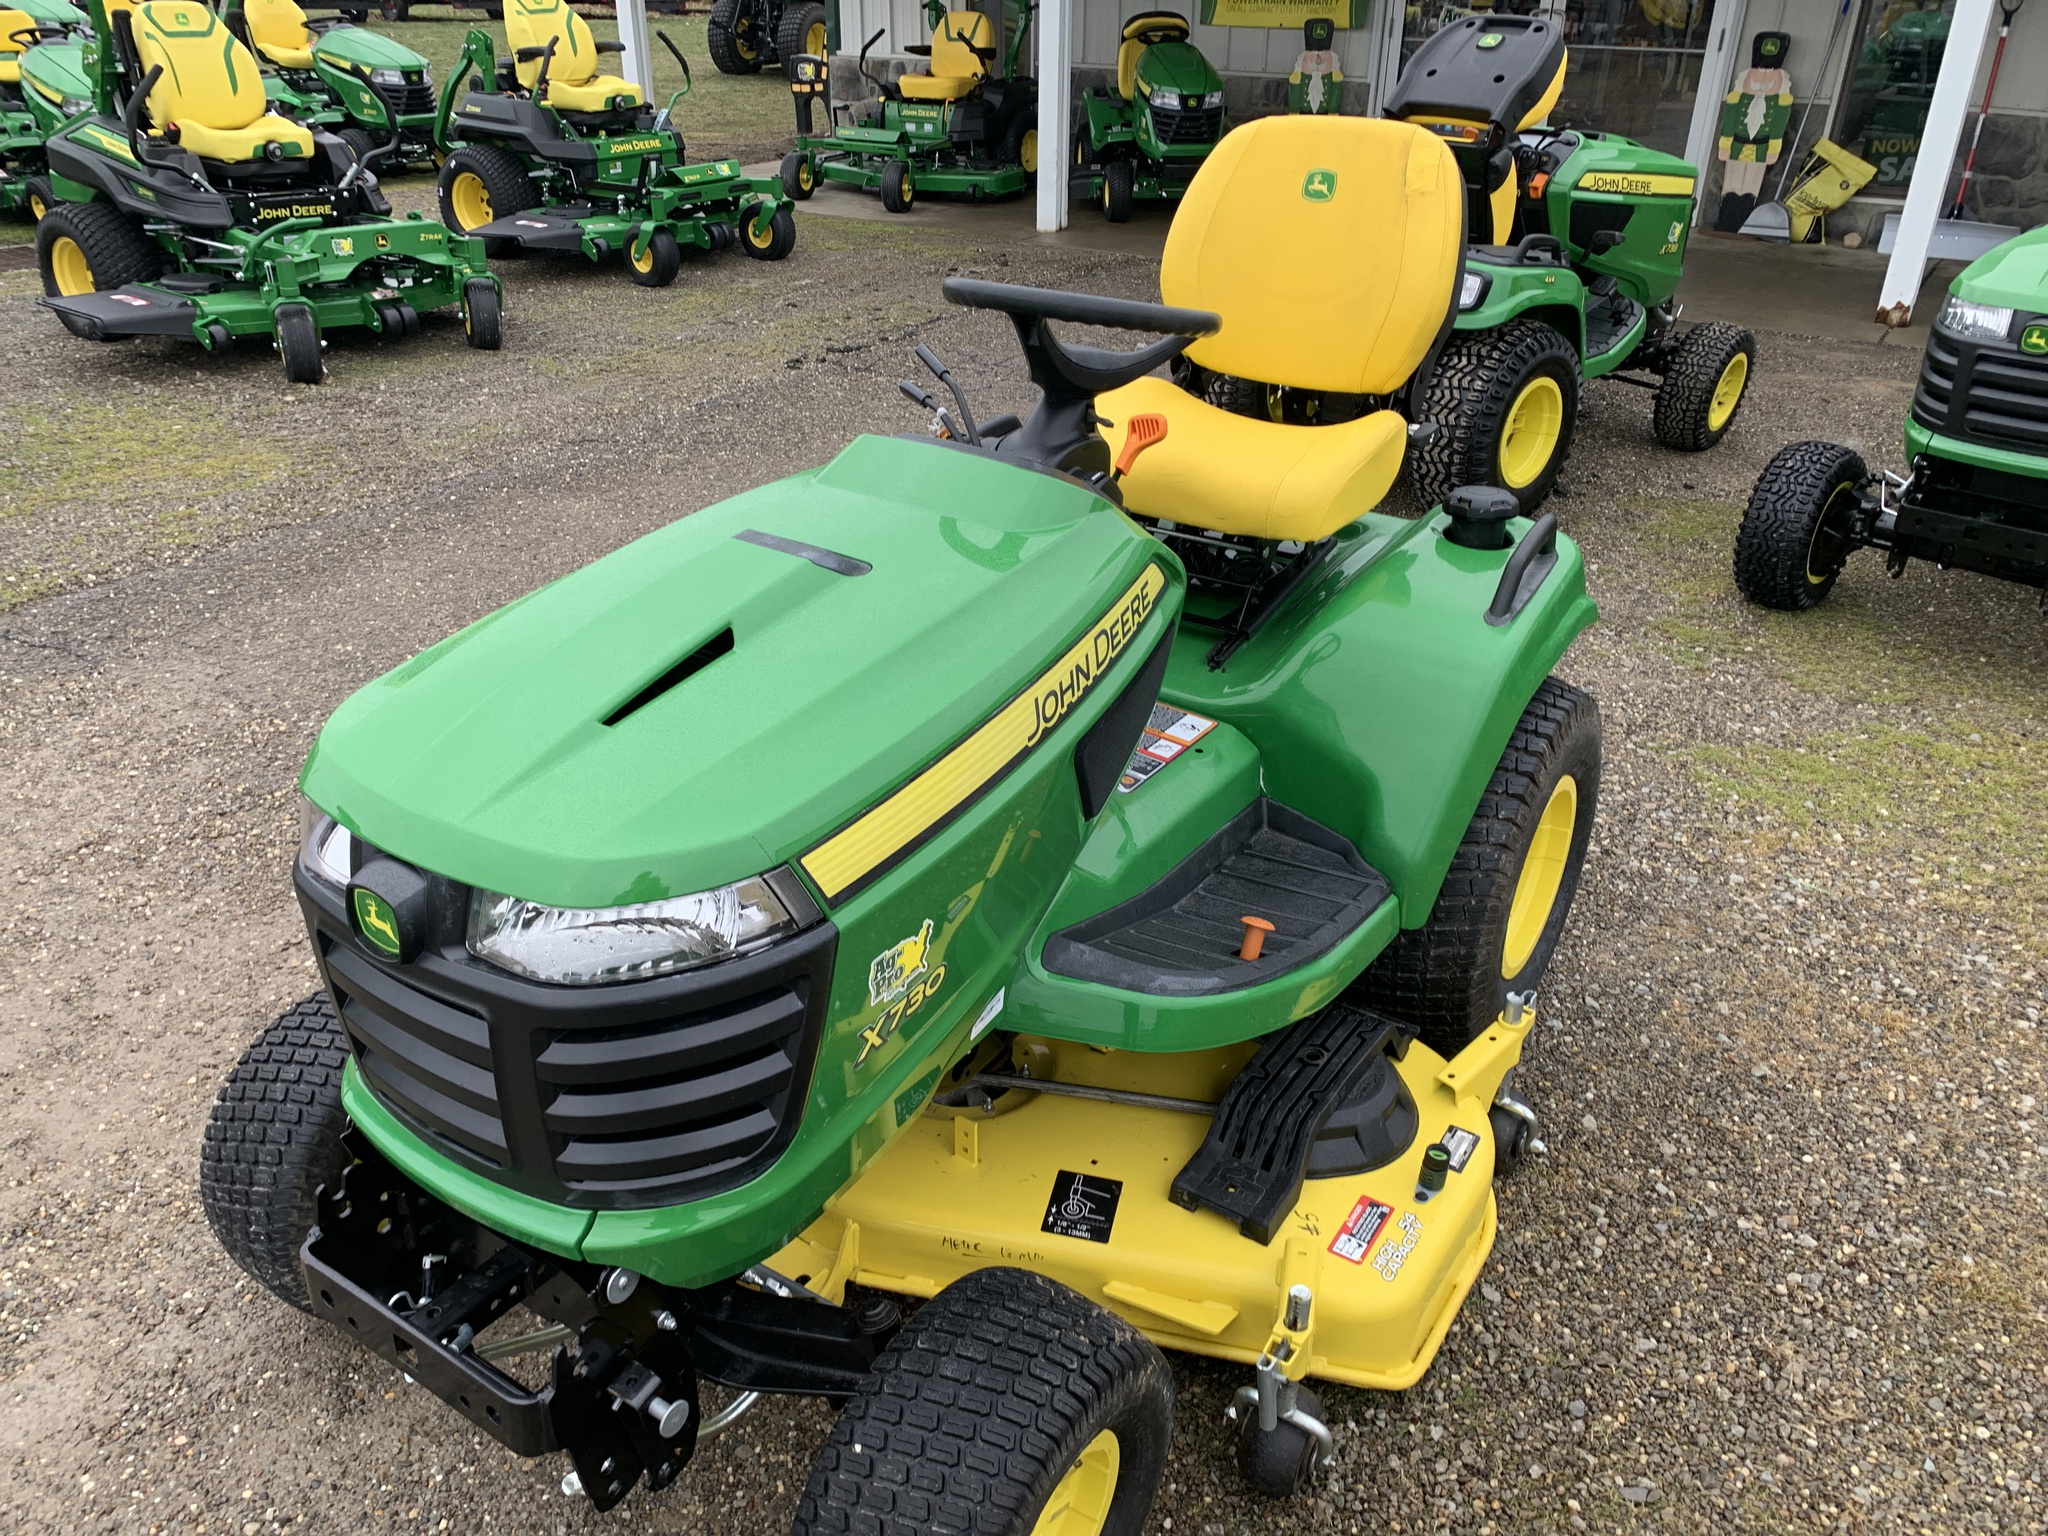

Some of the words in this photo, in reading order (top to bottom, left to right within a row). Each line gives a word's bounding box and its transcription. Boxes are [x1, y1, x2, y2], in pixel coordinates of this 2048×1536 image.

[1249, 6, 1278, 14] COMPACT
[1279, 6, 1304, 14] UTILITY
[1305, 6, 1337, 15] TRACTORS
[901, 108, 917, 116] JOHN
[918, 108, 938, 117] DEERE
[610, 142, 632, 153] JOHN
[632, 139, 661, 151] DEERE
[1872, 139, 1920, 153] NOW
[1590, 175, 1619, 191] JOHN
[1621, 177, 1652, 192] DEERE
[257, 207, 290, 220] JOHN
[292, 204, 333, 217] DEERE
[1027, 652, 1091, 743] JOHN
[1093, 579, 1150, 672] DEERE
[874, 964, 905, 999] Pro
[855, 964, 947, 1066] X730
[1371, 1238, 1399, 1272] HIGH
[1397, 1210, 1416, 1232] 54
[1381, 1220, 1424, 1282] CAPACITY
